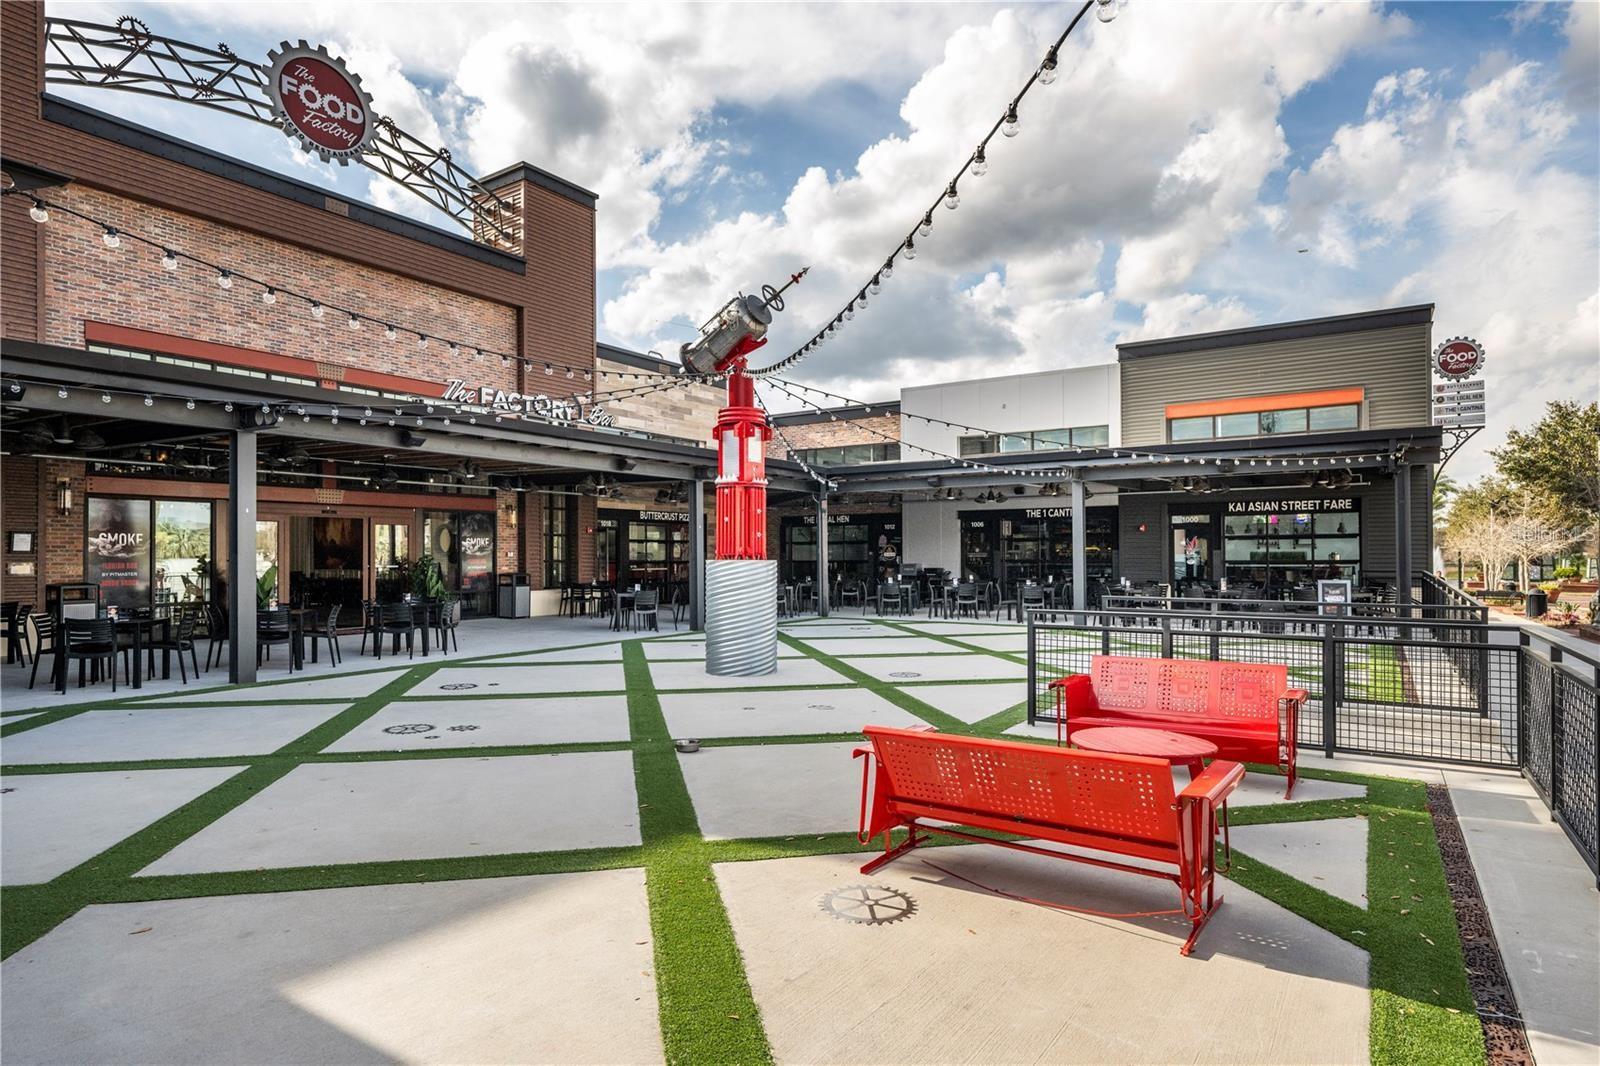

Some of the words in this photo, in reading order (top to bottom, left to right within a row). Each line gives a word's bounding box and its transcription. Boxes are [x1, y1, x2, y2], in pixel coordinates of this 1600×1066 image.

[294, 65, 316, 82] The
[282, 74, 364, 124] FOOD
[280, 111, 305, 140] MICRO
[309, 142, 366, 157] RESTAURANTS
[302, 109, 358, 146] Factory
[1440, 351, 1476, 362] FOOD
[441, 379, 476, 403] The
[481, 387, 576, 420] FACTORY
[589, 405, 616, 427] Bar
[1229, 502, 1245, 512] KAI
[1247, 501, 1279, 511] ASIAN
[1281, 500, 1321, 511] STREET
[1323, 499, 1352, 510] FARE
[640, 511, 678, 521] BUTTERCRUST
[679, 513, 690, 521] PIZZ
[803, 516, 815, 524] THE
[836, 515, 850, 523] HEN
[1026, 509, 1041, 518] THE
[1048, 508, 1072, 518] CANTI
[99, 532, 144, 546] SMOKE
[466, 537, 490, 547] SMOKE
